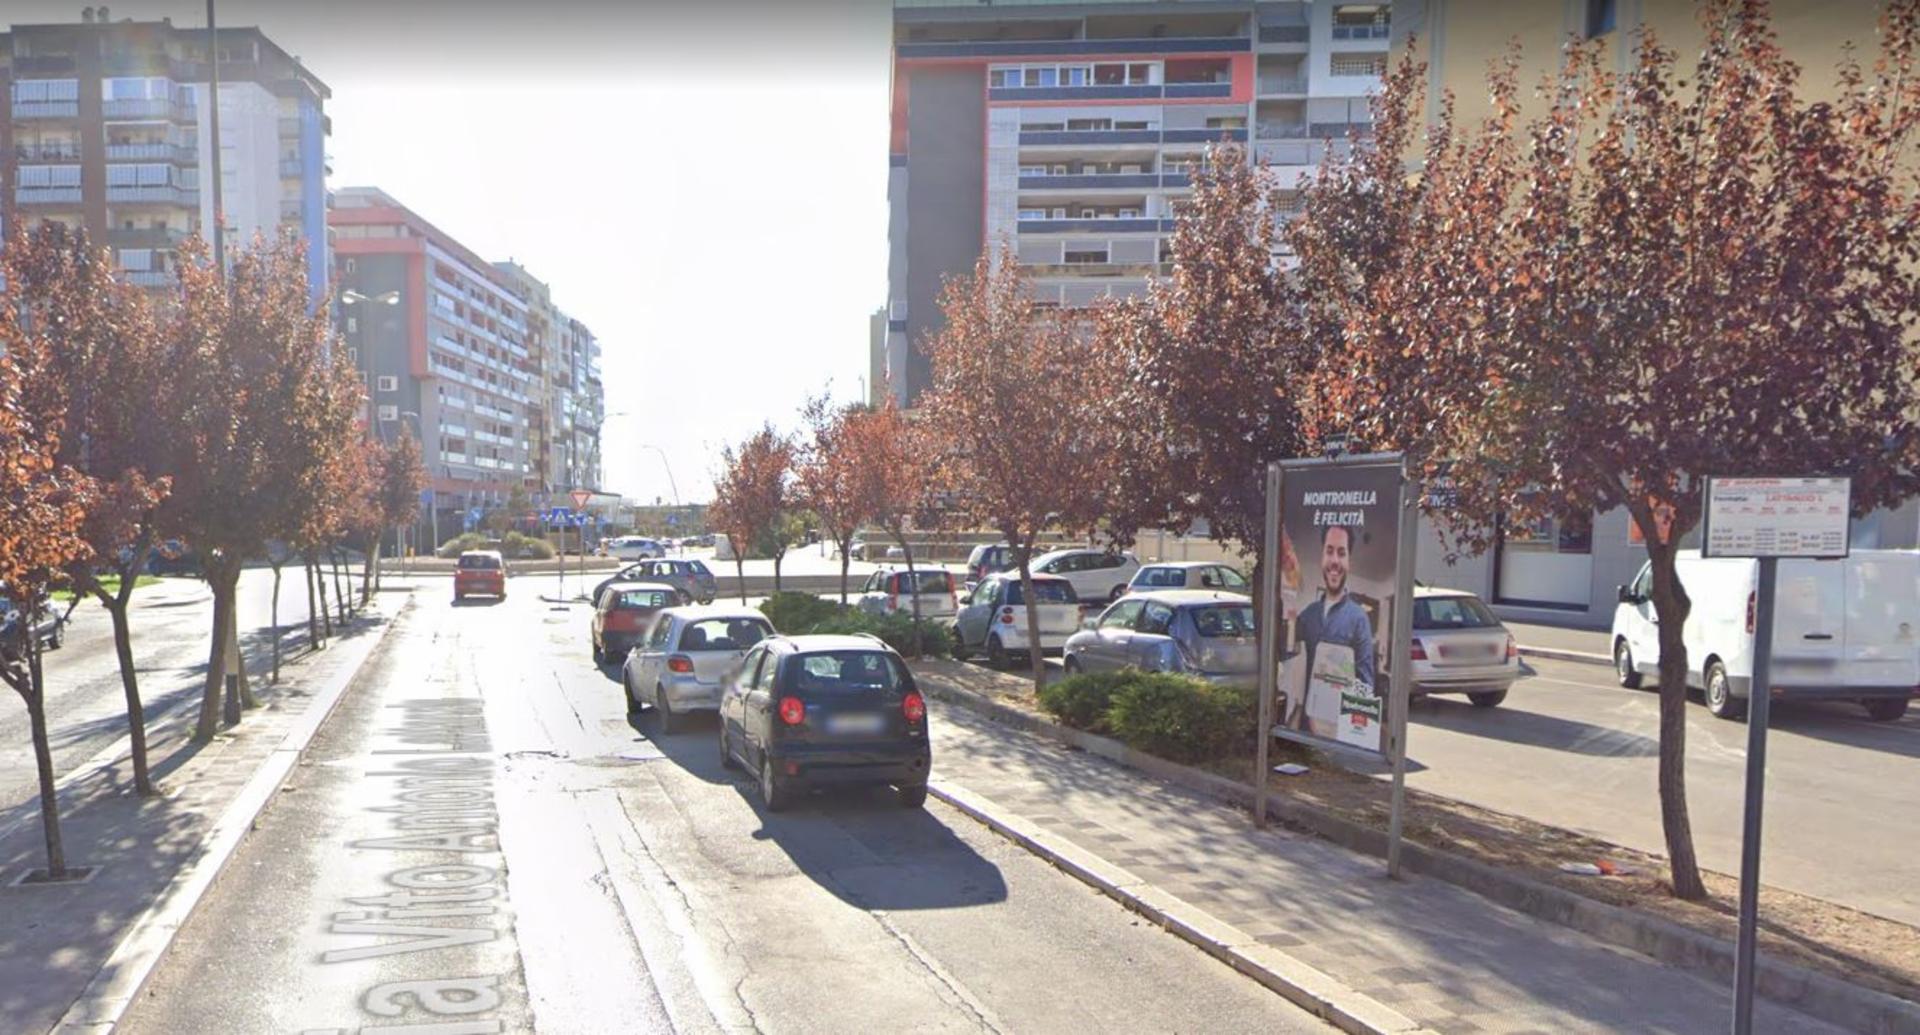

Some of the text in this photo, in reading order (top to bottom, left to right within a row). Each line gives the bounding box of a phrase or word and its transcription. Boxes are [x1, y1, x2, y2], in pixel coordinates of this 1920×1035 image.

[1303, 490, 1377, 506] MONTRONELLA
[1313, 508, 1365, 526] È FELICITÀ
